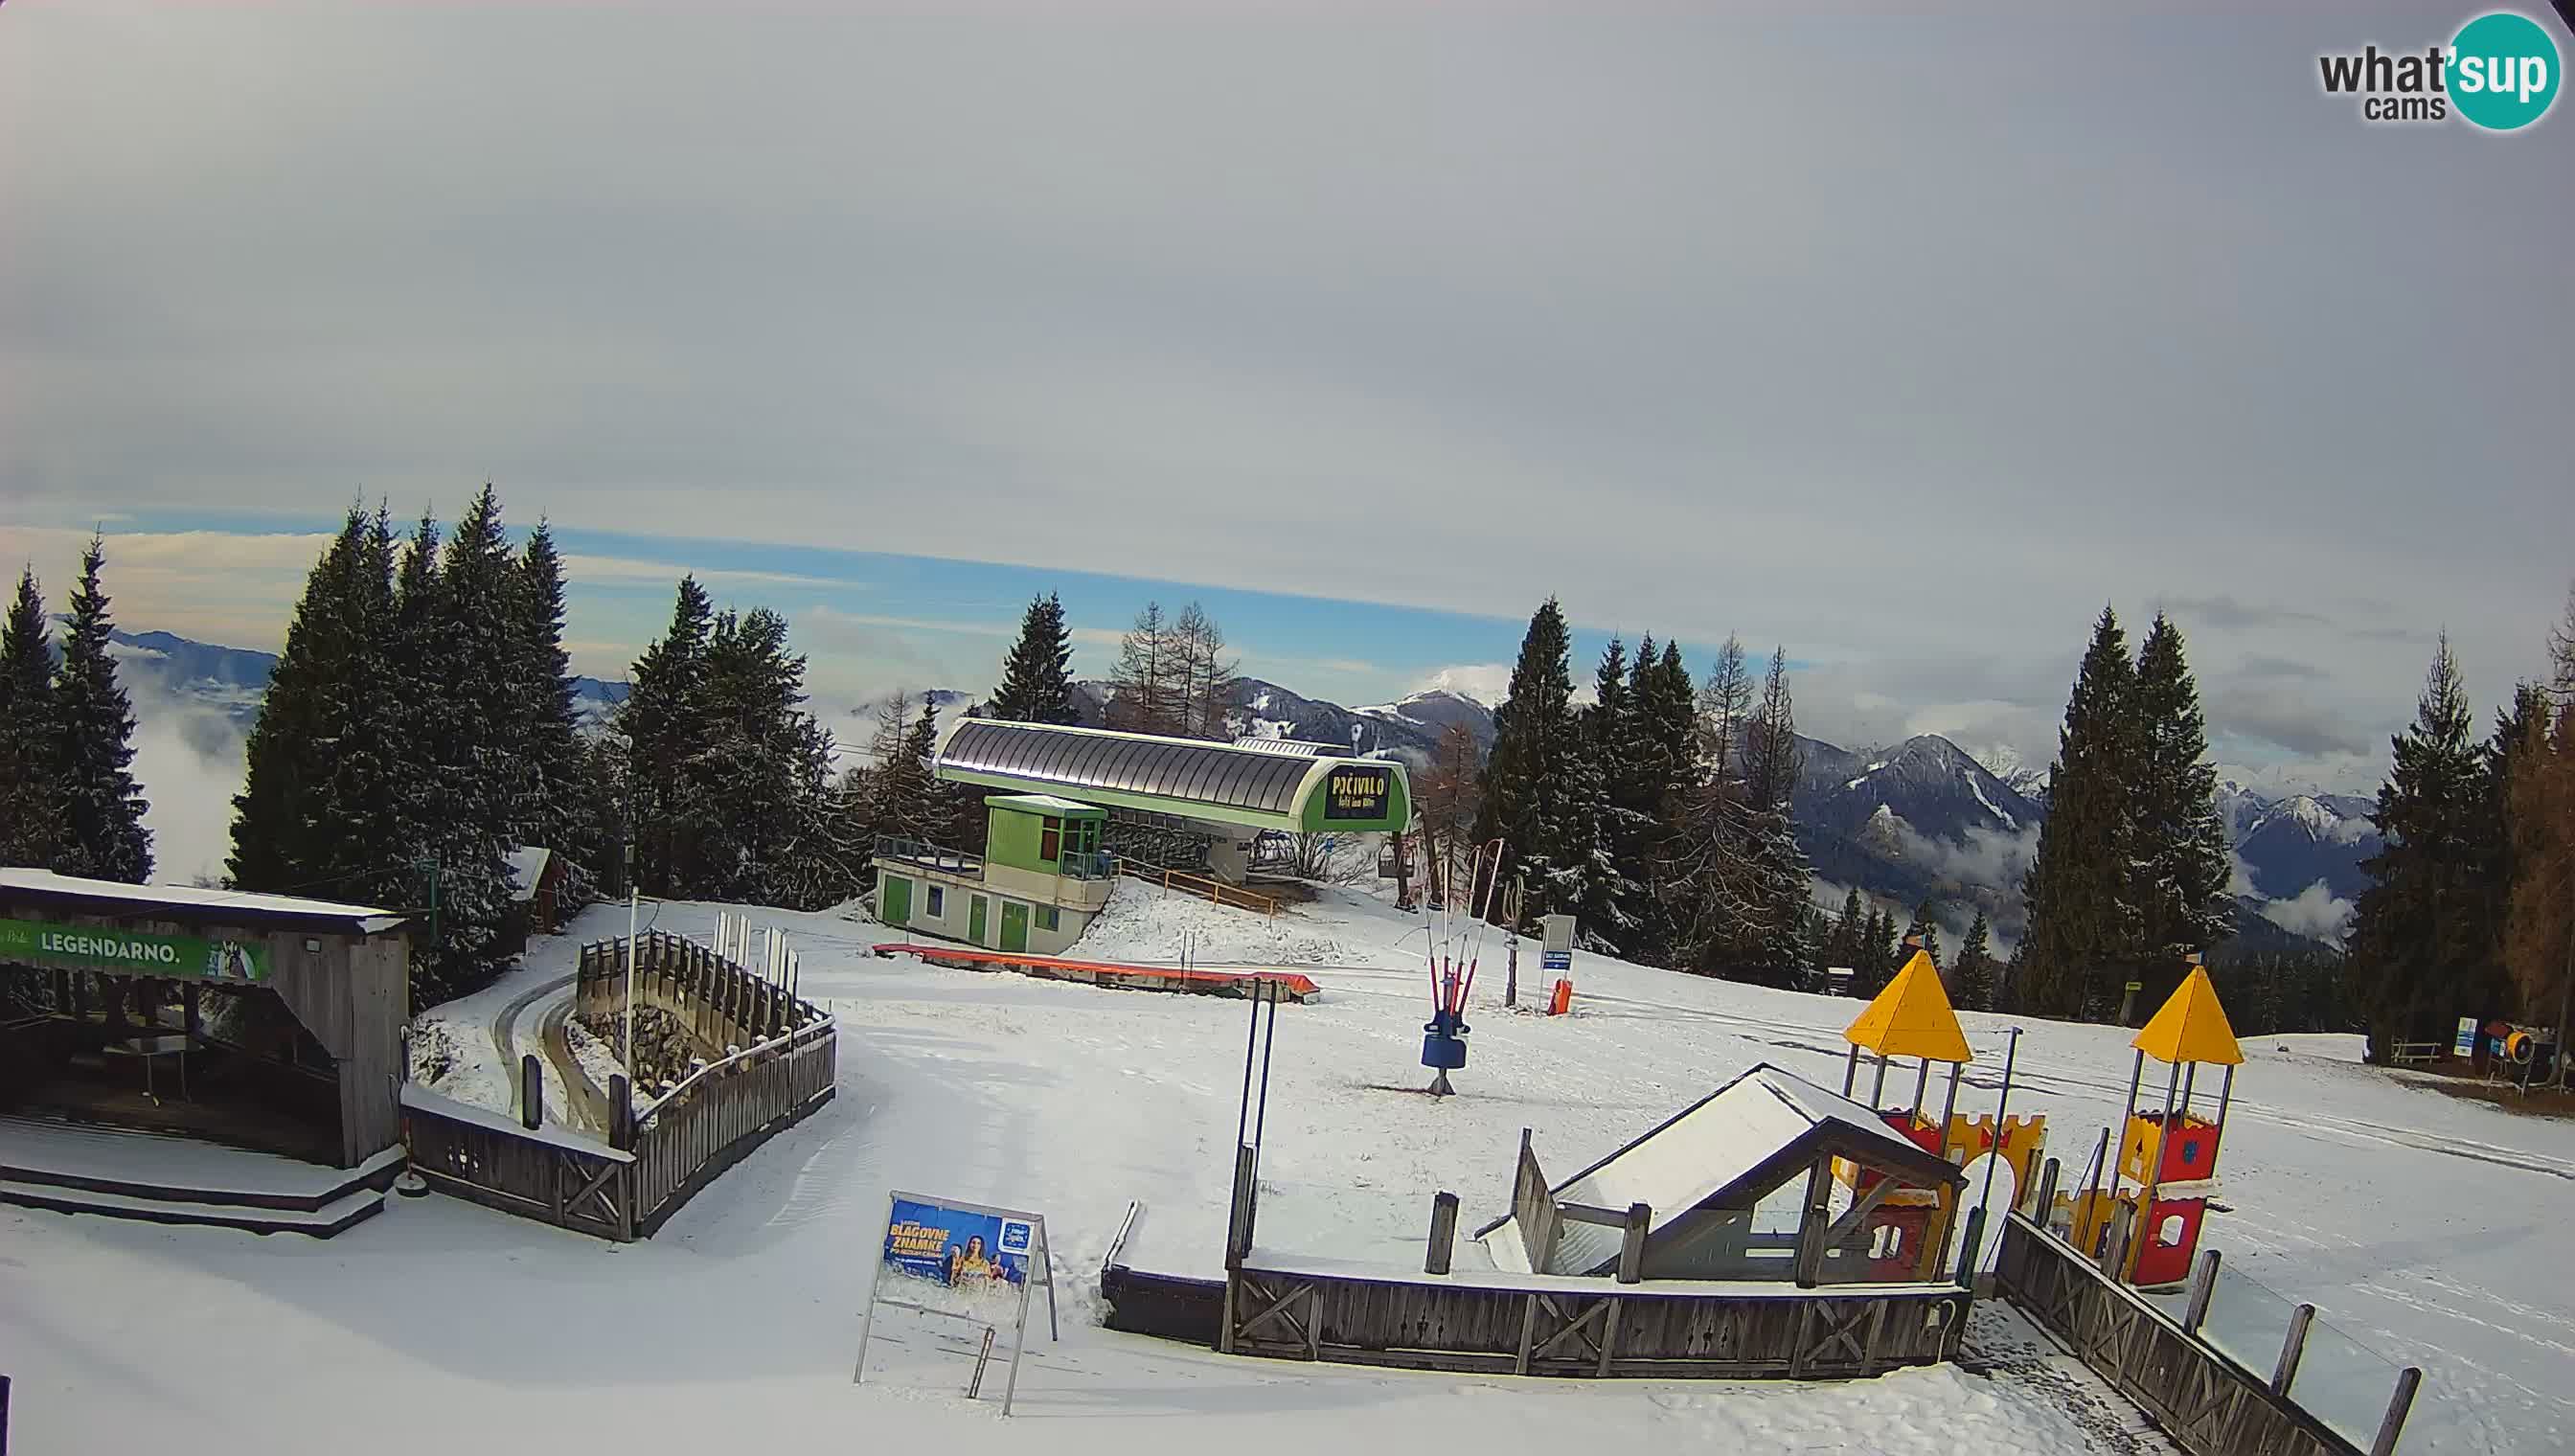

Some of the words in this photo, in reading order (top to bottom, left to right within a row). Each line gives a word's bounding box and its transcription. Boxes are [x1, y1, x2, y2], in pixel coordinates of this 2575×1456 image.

[40, 932, 181, 964] LEGENDARNO.
[889, 1223, 951, 1240] BLAGOVNE
[893, 1236, 944, 1251] ZNAMKE
